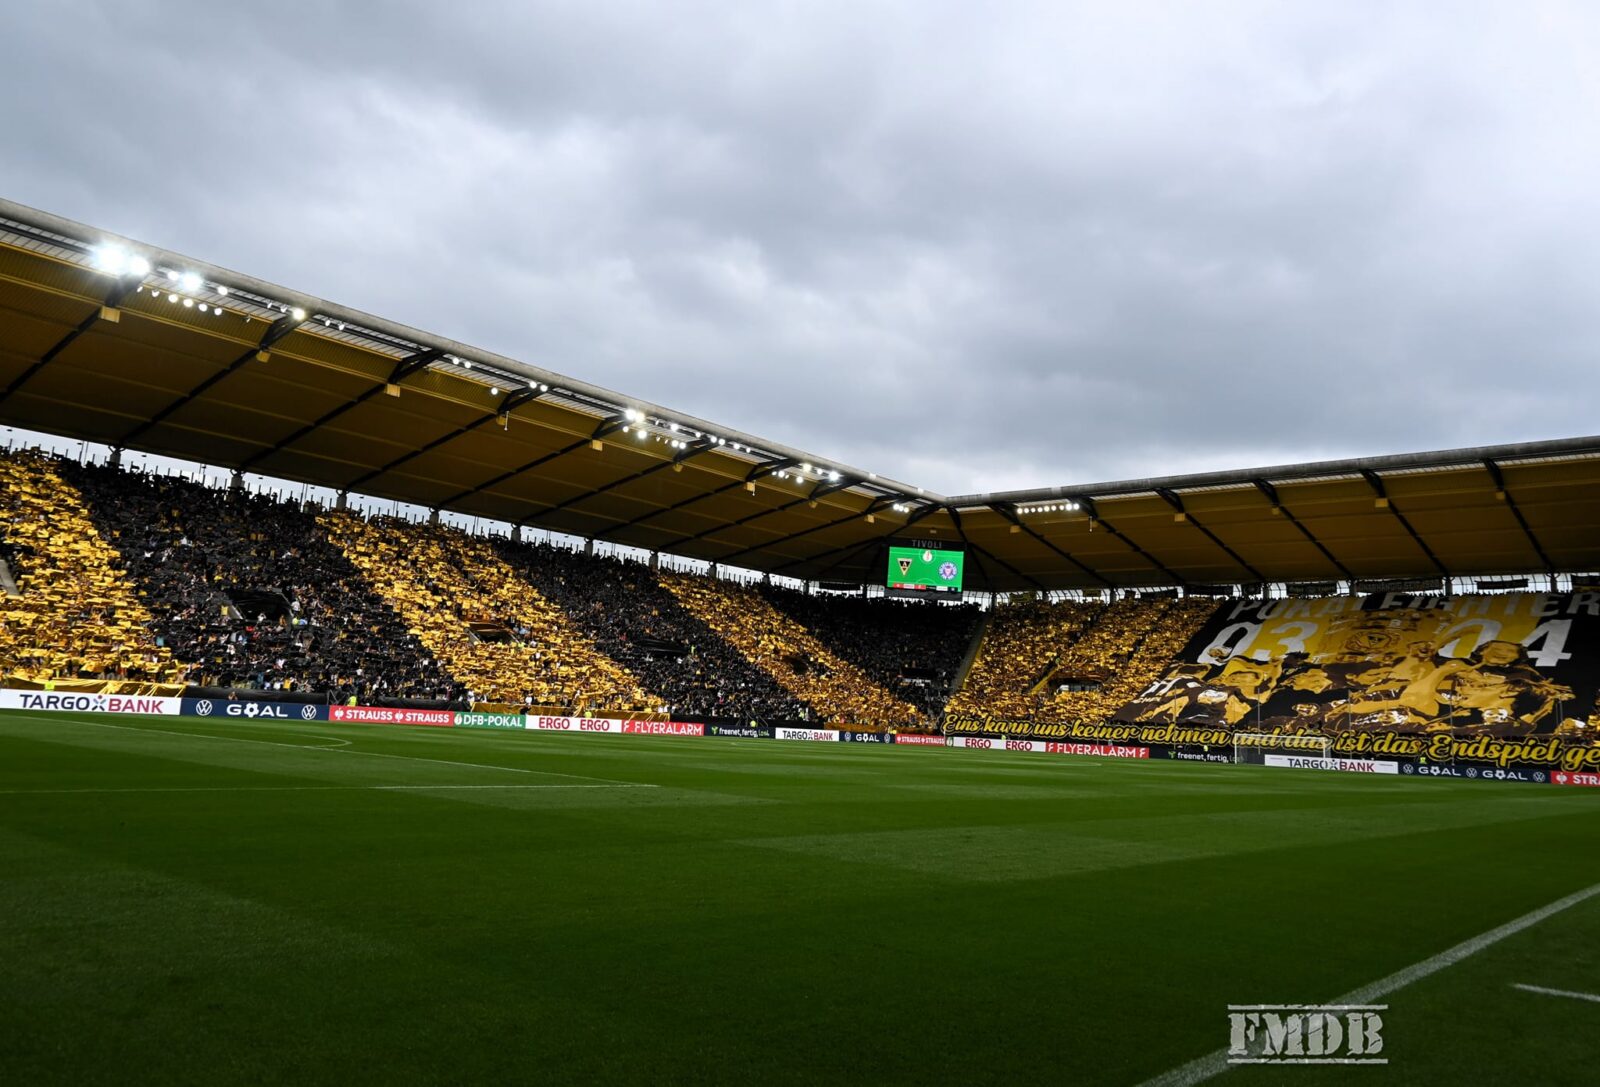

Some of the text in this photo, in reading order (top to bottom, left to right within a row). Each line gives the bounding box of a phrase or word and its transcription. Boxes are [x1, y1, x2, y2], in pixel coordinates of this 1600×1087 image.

[912, 539, 942, 549] TIVOLI
[346, 709, 450, 723] STRAUSS STRAUSS
[463, 714, 523, 727] DFB-POKAL
[538, 717, 610, 732] ERGO ERGO
[634, 721, 702, 735] FLYERALARM
[925, 737, 945, 745] STRAUSS
[943, 714, 980, 732] Eins
[983, 716, 1032, 734] kann
[1033, 722, 1068, 736] uns
[1071, 719, 1138, 739] keiner
[1141, 723, 1230, 744] nehmen
[1233, 726, 1282, 748] und
[1284, 727, 1330, 749] das
[1335, 731, 1372, 751] ist
[1373, 732, 1423, 754] das
[1428, 734, 1561, 767] Endspiel
[965, 738, 1033, 751] ERGO ERGO
[1056, 742, 1136, 758] FLYERALARM
